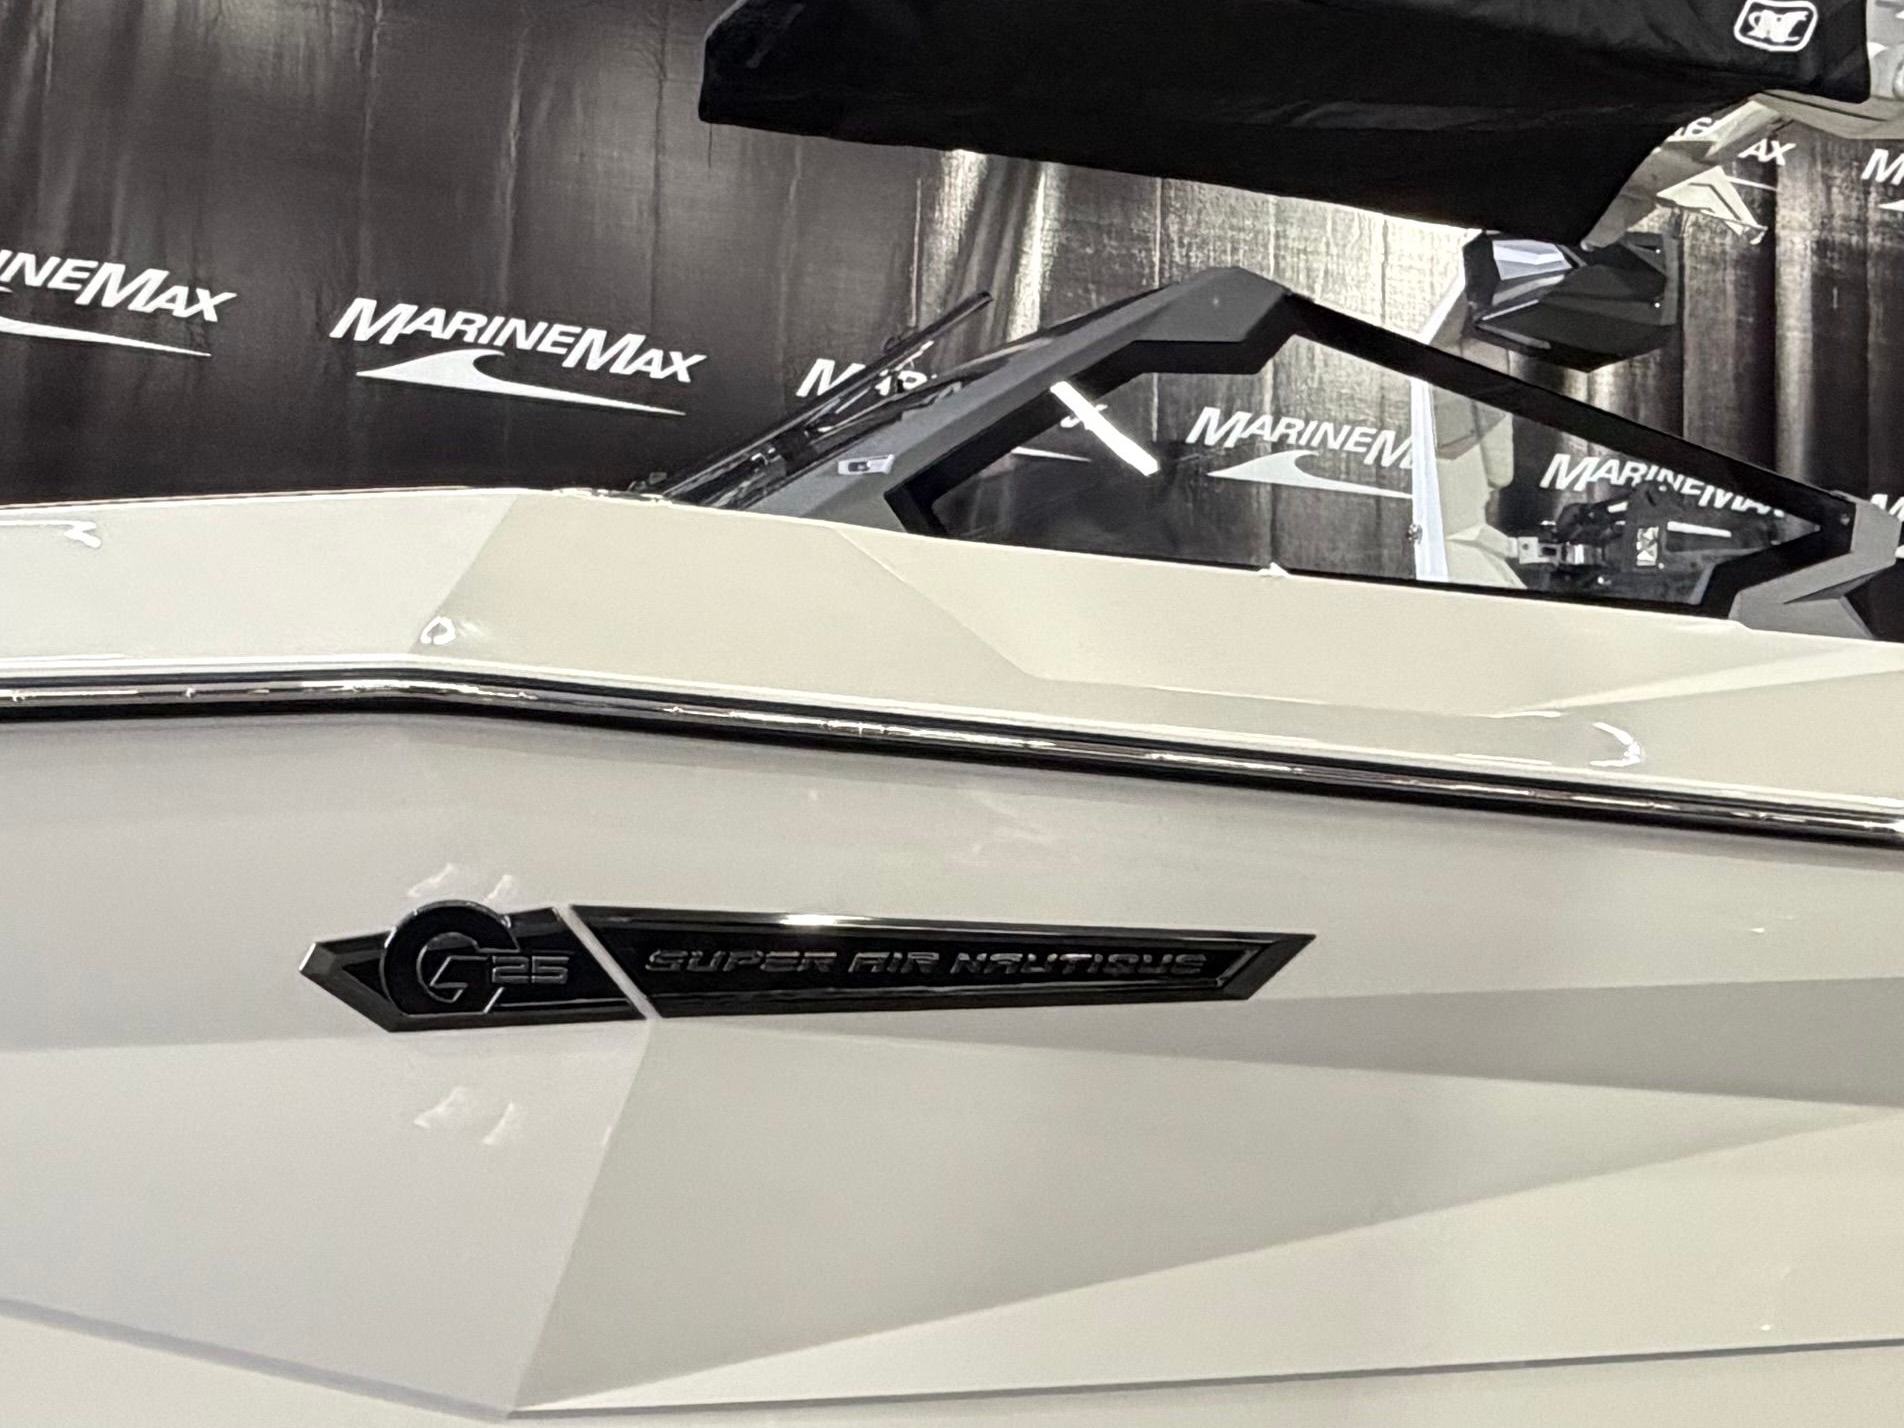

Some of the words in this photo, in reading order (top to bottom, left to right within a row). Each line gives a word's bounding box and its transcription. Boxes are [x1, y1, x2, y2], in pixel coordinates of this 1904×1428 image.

[1185, 406, 1413, 470] MARINEM
[645, 949, 838, 972] SUPER
[848, 951, 940, 974] AIR
